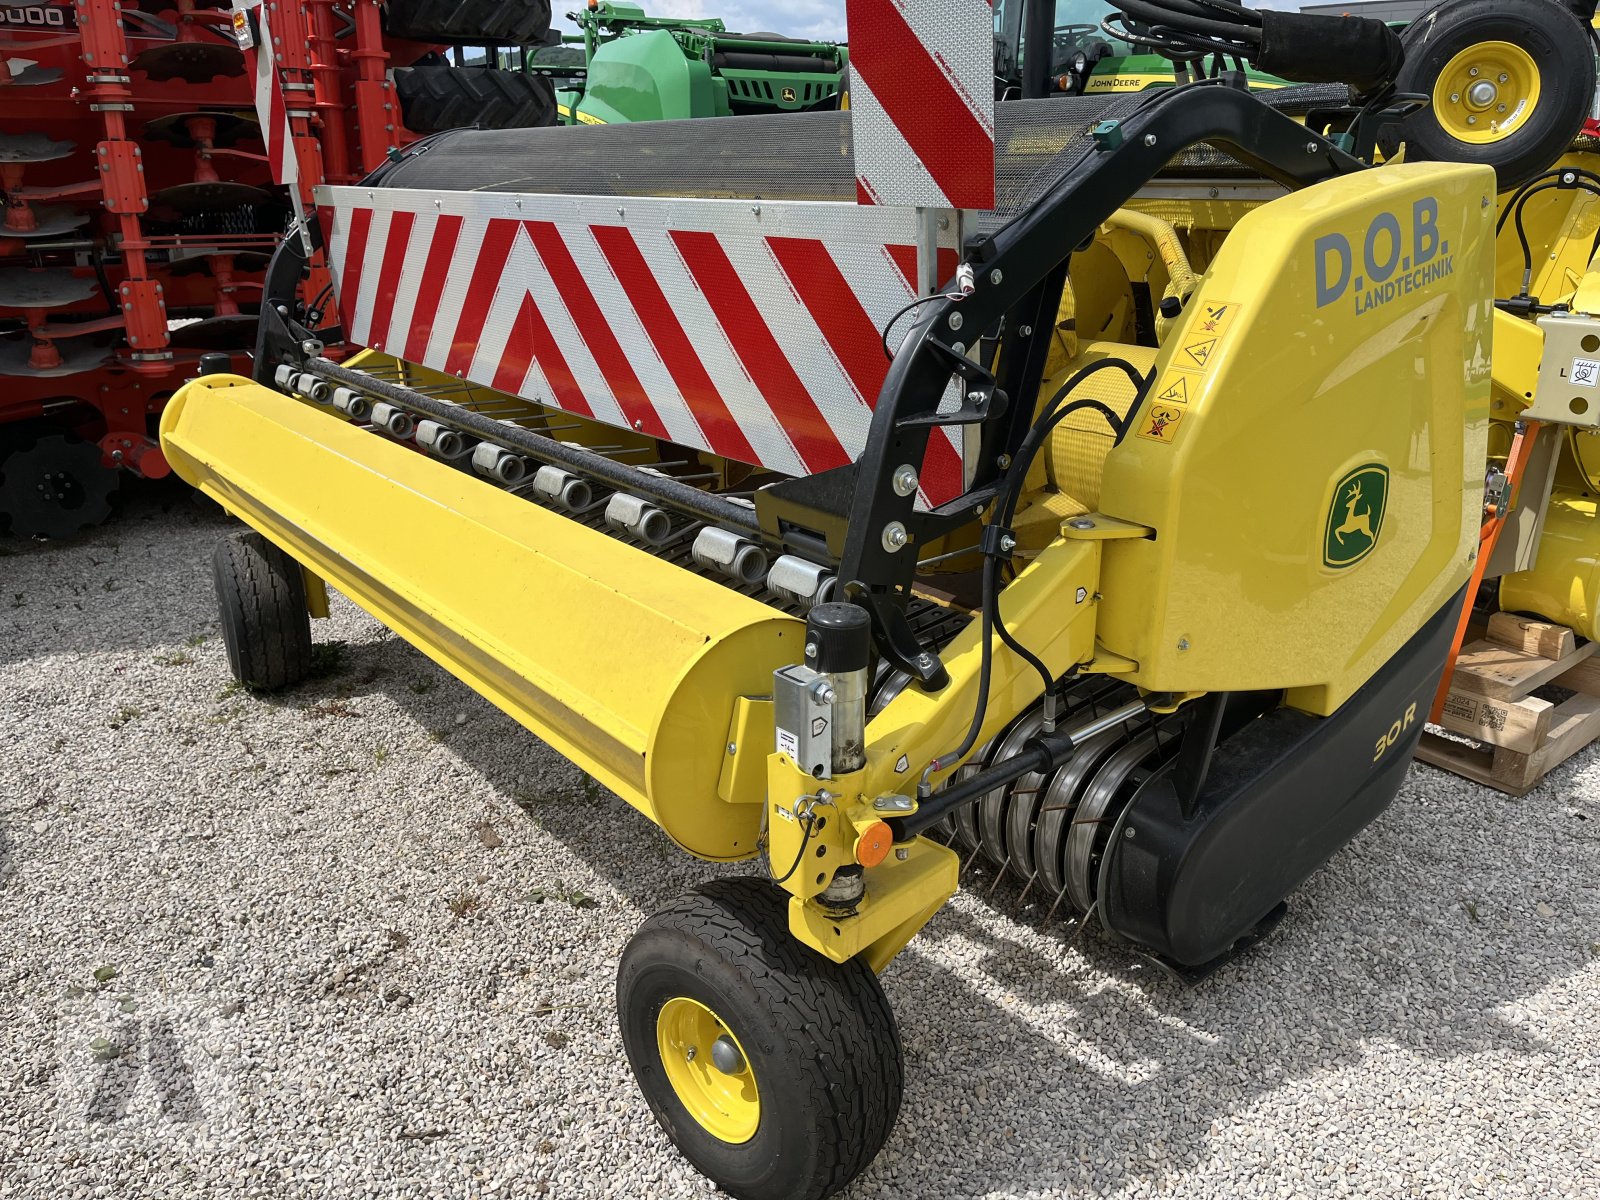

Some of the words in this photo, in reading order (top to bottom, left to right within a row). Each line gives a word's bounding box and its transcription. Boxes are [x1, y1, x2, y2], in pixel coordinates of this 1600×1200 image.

[1091, 79, 1112, 87] JOHN
[1113, 78, 1141, 87] DEERE
[1314, 196, 1449, 309] D.O.B.
[1355, 255, 1454, 317] LANDTECHNIK
[1452, 695, 1470, 706] 2024
[1373, 720, 1402, 762] 30
[1403, 702, 1417, 732] R
